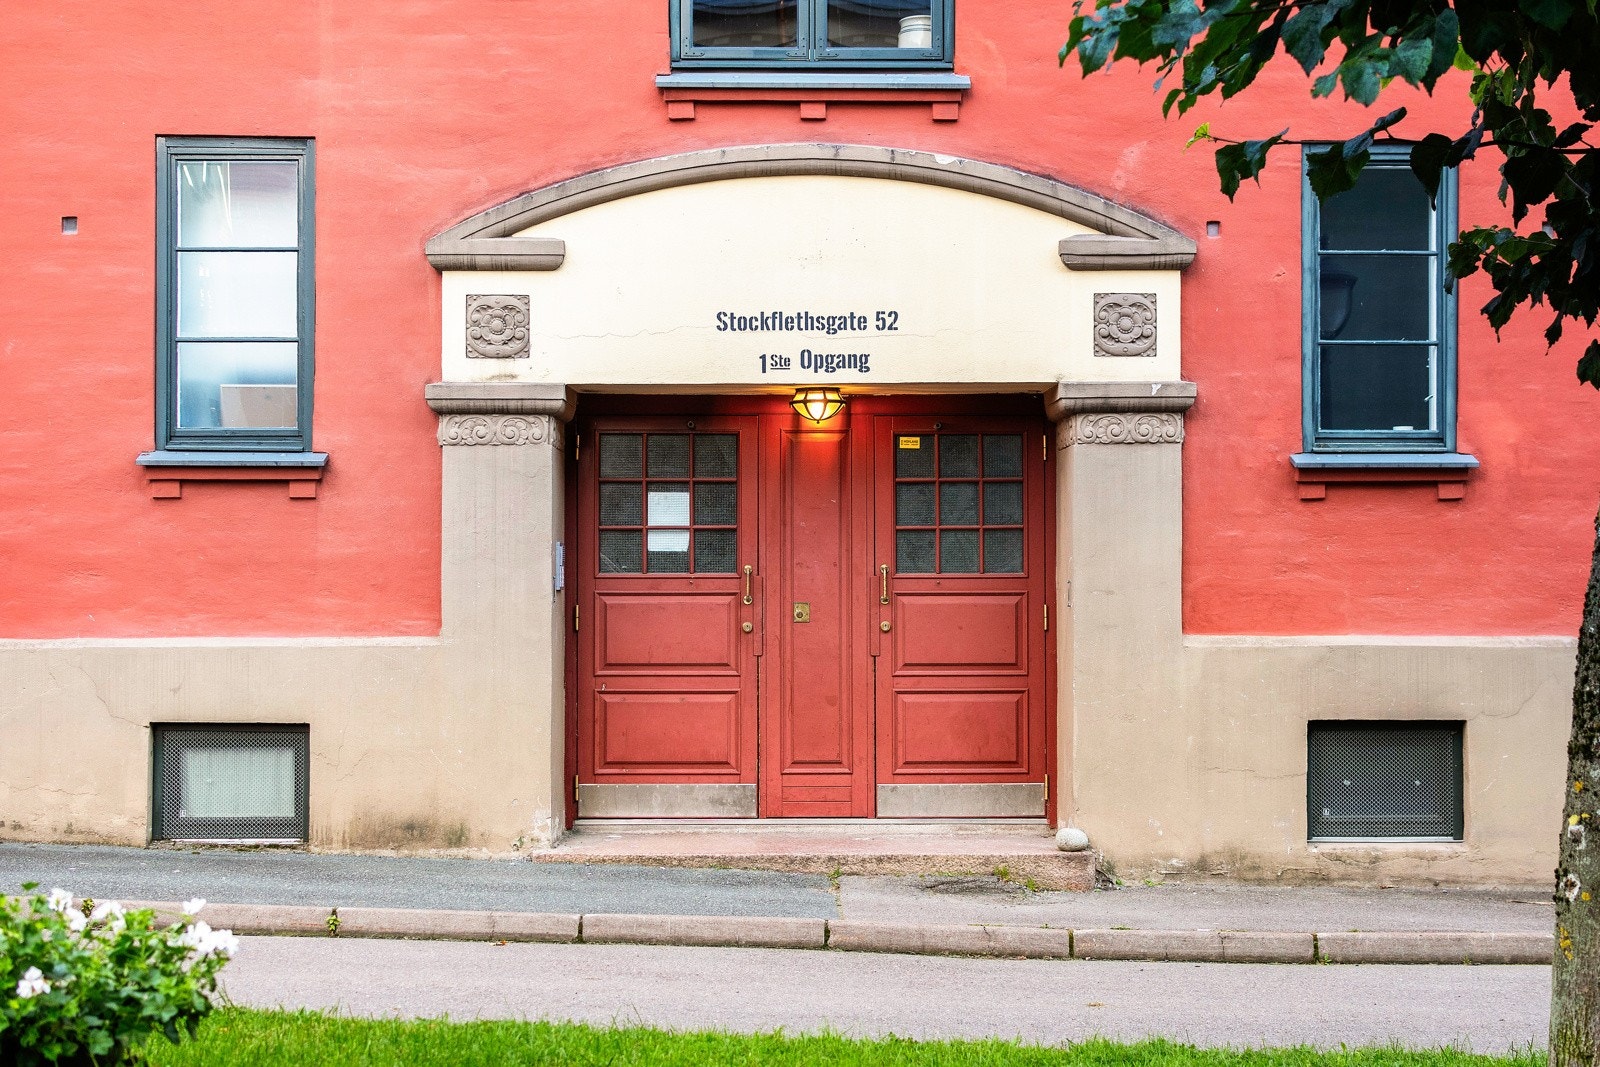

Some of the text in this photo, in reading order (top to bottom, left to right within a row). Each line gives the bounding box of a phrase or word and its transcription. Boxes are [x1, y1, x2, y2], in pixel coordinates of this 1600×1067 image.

[716, 310, 899, 335] Stockflethsgate 52
[799, 348, 871, 374] Opgang
